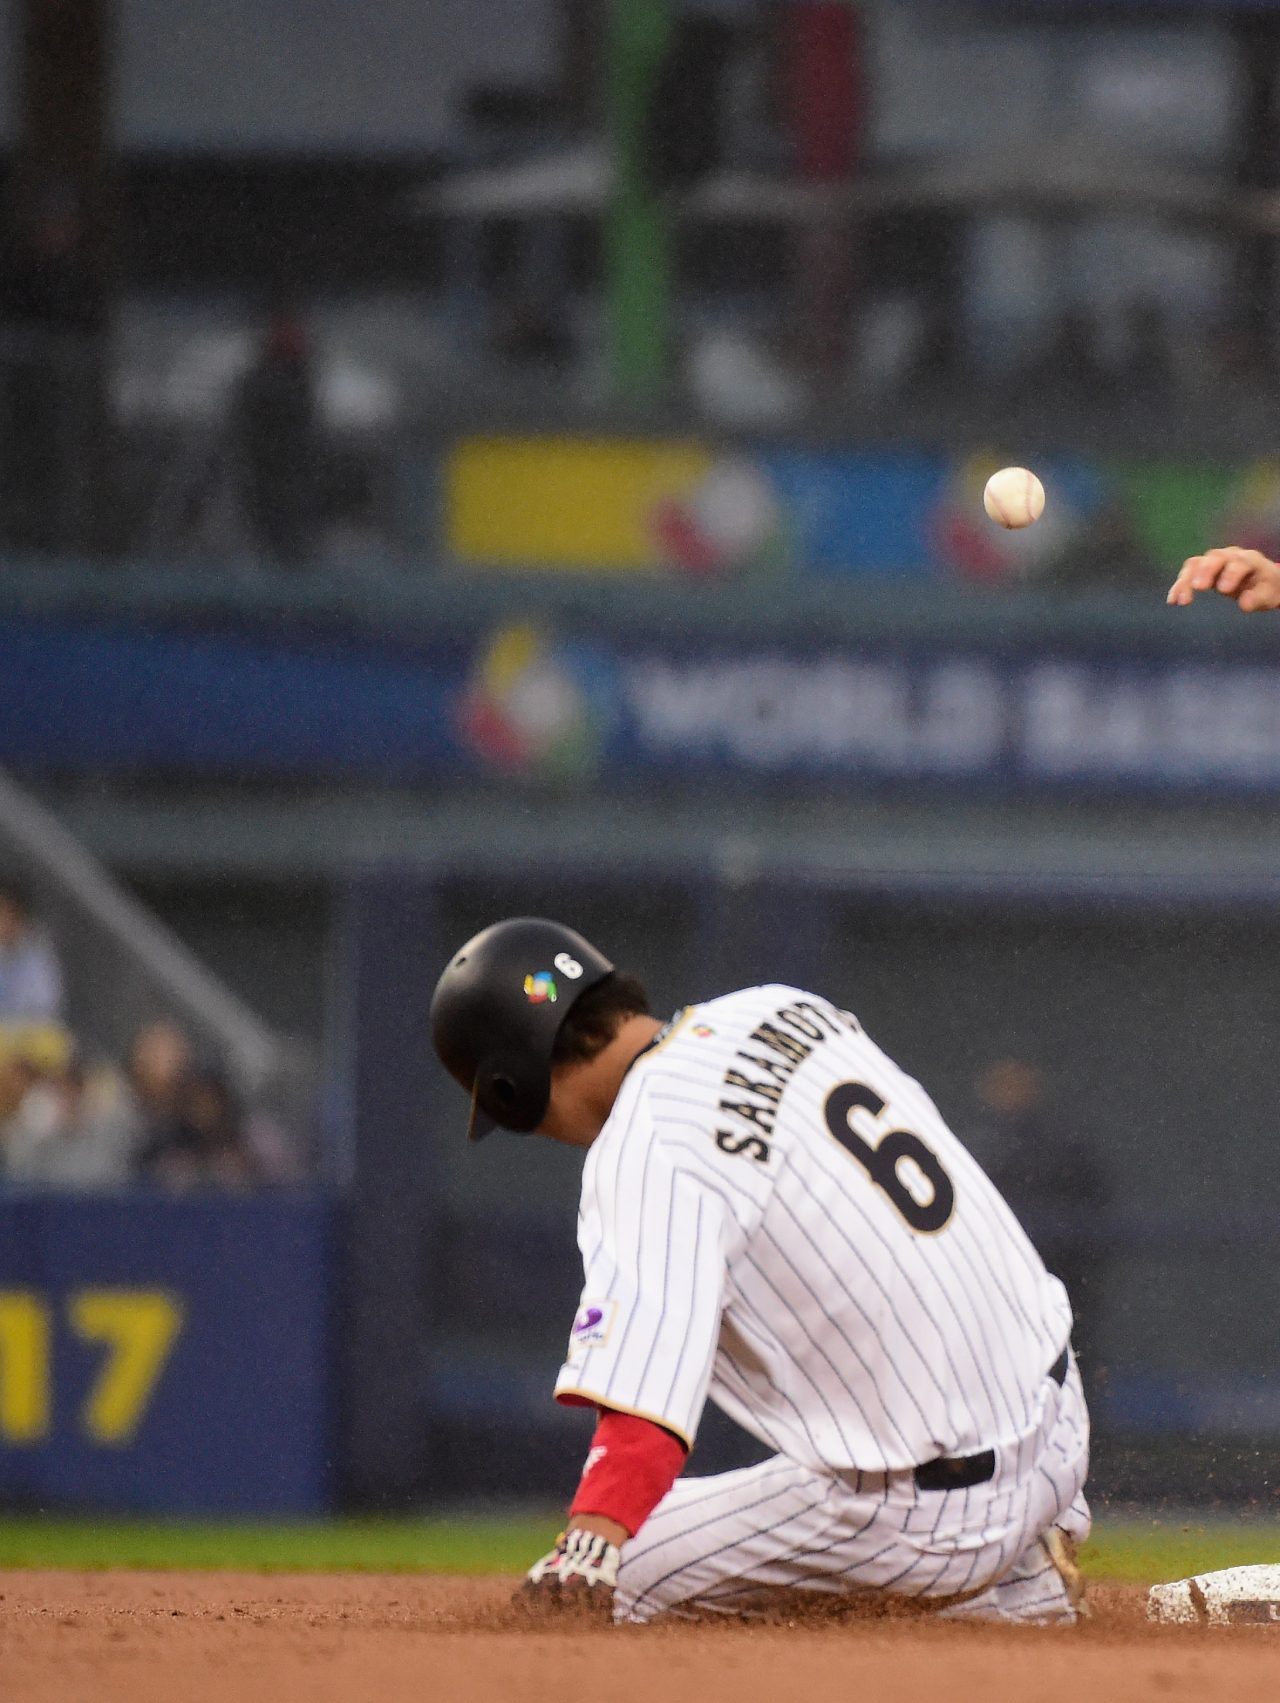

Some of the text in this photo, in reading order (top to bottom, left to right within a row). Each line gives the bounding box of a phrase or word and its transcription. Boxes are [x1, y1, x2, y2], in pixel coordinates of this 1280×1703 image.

[630, 660, 1003, 770] WORLD
[553, 952, 584, 980] 6
[822, 1079, 956, 1236] 6
[0, 1289, 180, 1441] 17
